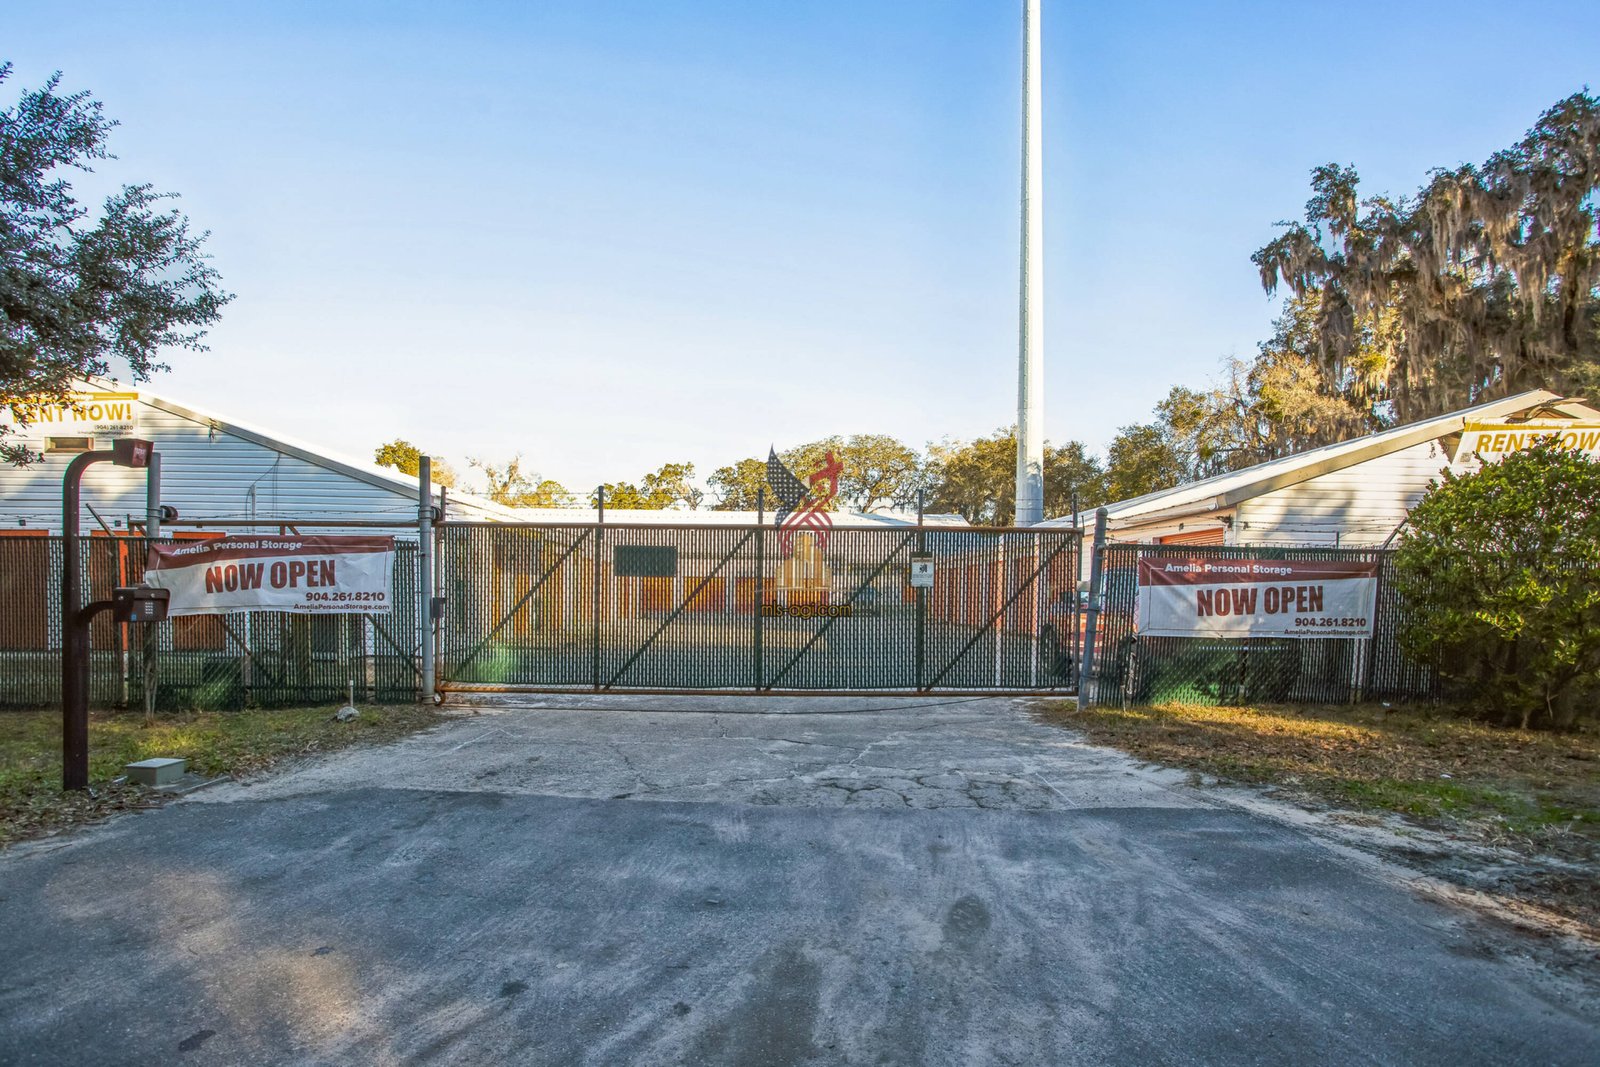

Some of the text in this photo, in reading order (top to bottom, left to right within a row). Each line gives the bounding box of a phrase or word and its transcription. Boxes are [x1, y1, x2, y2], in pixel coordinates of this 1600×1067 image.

[71, 403, 132, 421] NOW!
[173, 540, 302, 555] Amelia Personal Storage
[1165, 563, 1293, 576] Amelia Personal Storage
[205, 559, 336, 594] NOW OPEN
[305, 592, 385, 602] 904.261.8210
[1196, 586, 1324, 617] NOW OPEN
[293, 603, 390, 611] AmeliaPersonalStorage.com
[1294, 617, 1367, 627] 904.261.8210
[1284, 628, 1370, 637] AmeliaPersonalStorage.com
